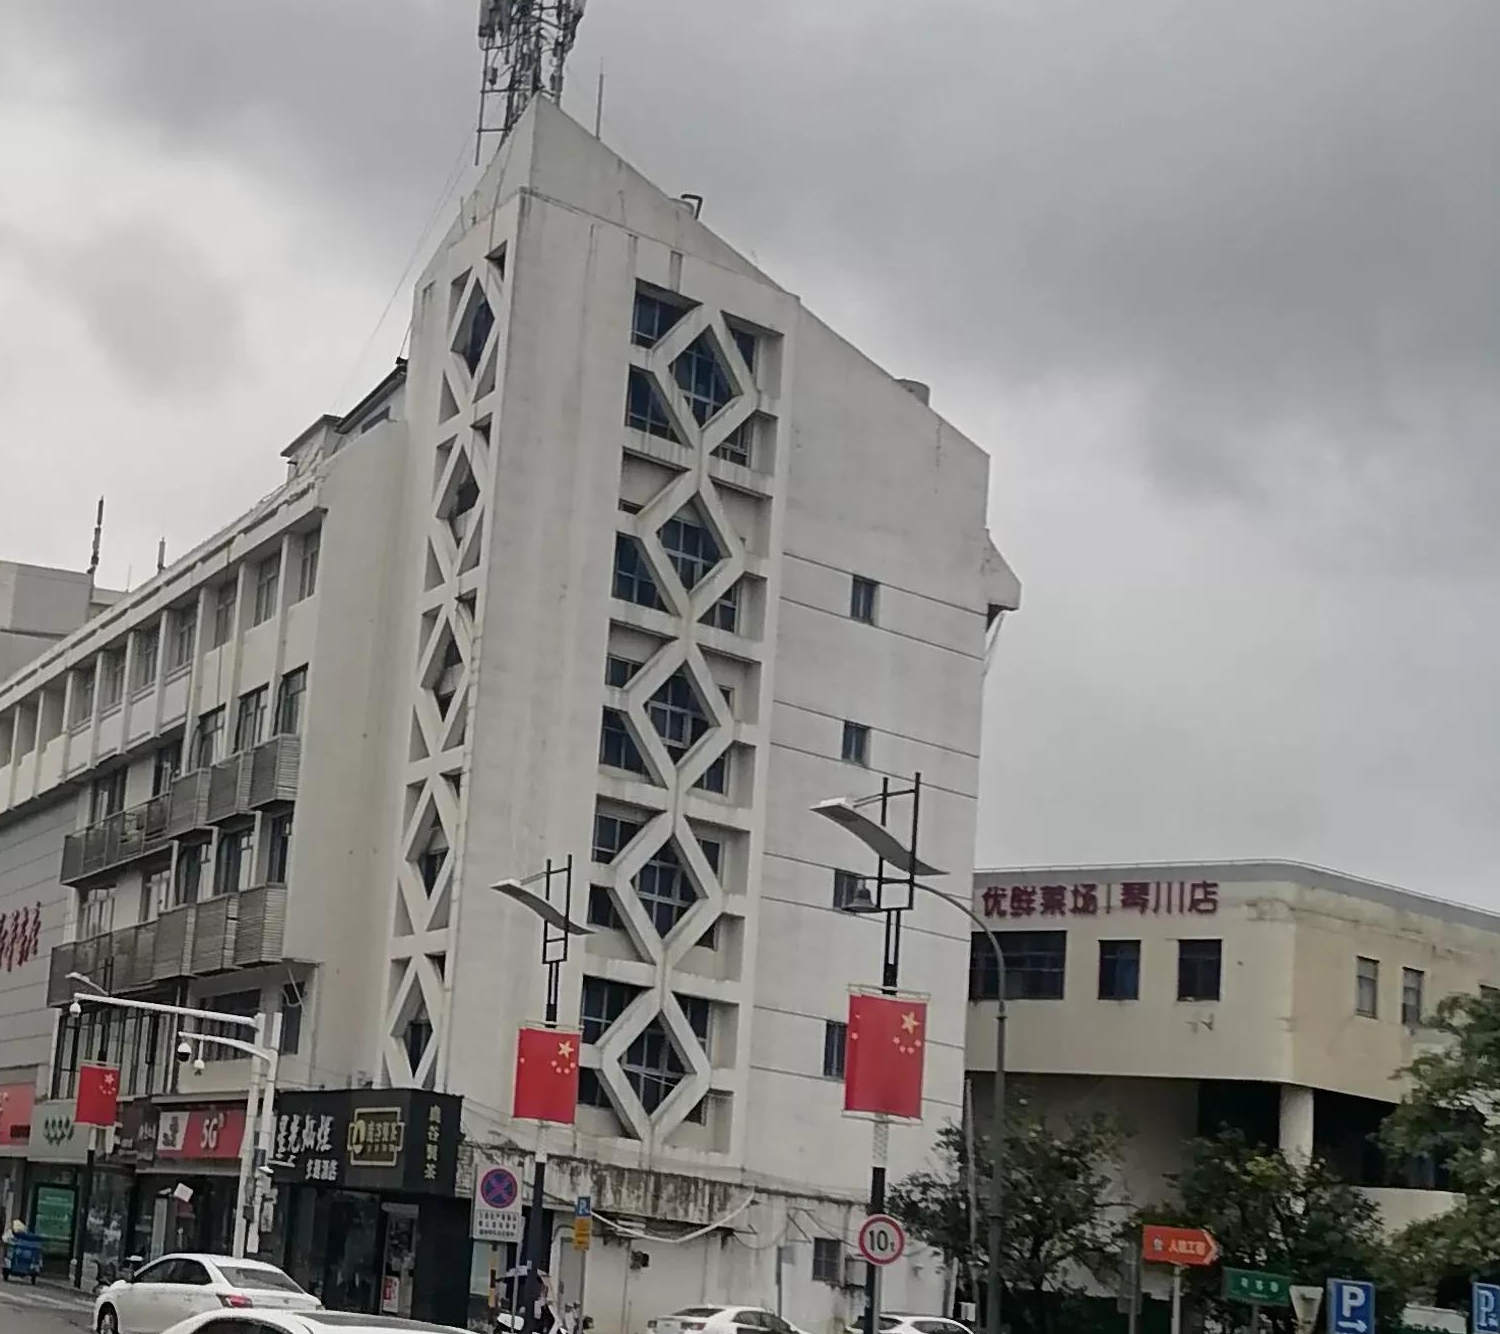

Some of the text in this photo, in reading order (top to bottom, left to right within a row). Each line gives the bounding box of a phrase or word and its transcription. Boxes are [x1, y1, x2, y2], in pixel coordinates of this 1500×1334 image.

[982, 881, 1219, 917] 优鲜菜场 琴川店
[1341, 1285, 1366, 1318] P
